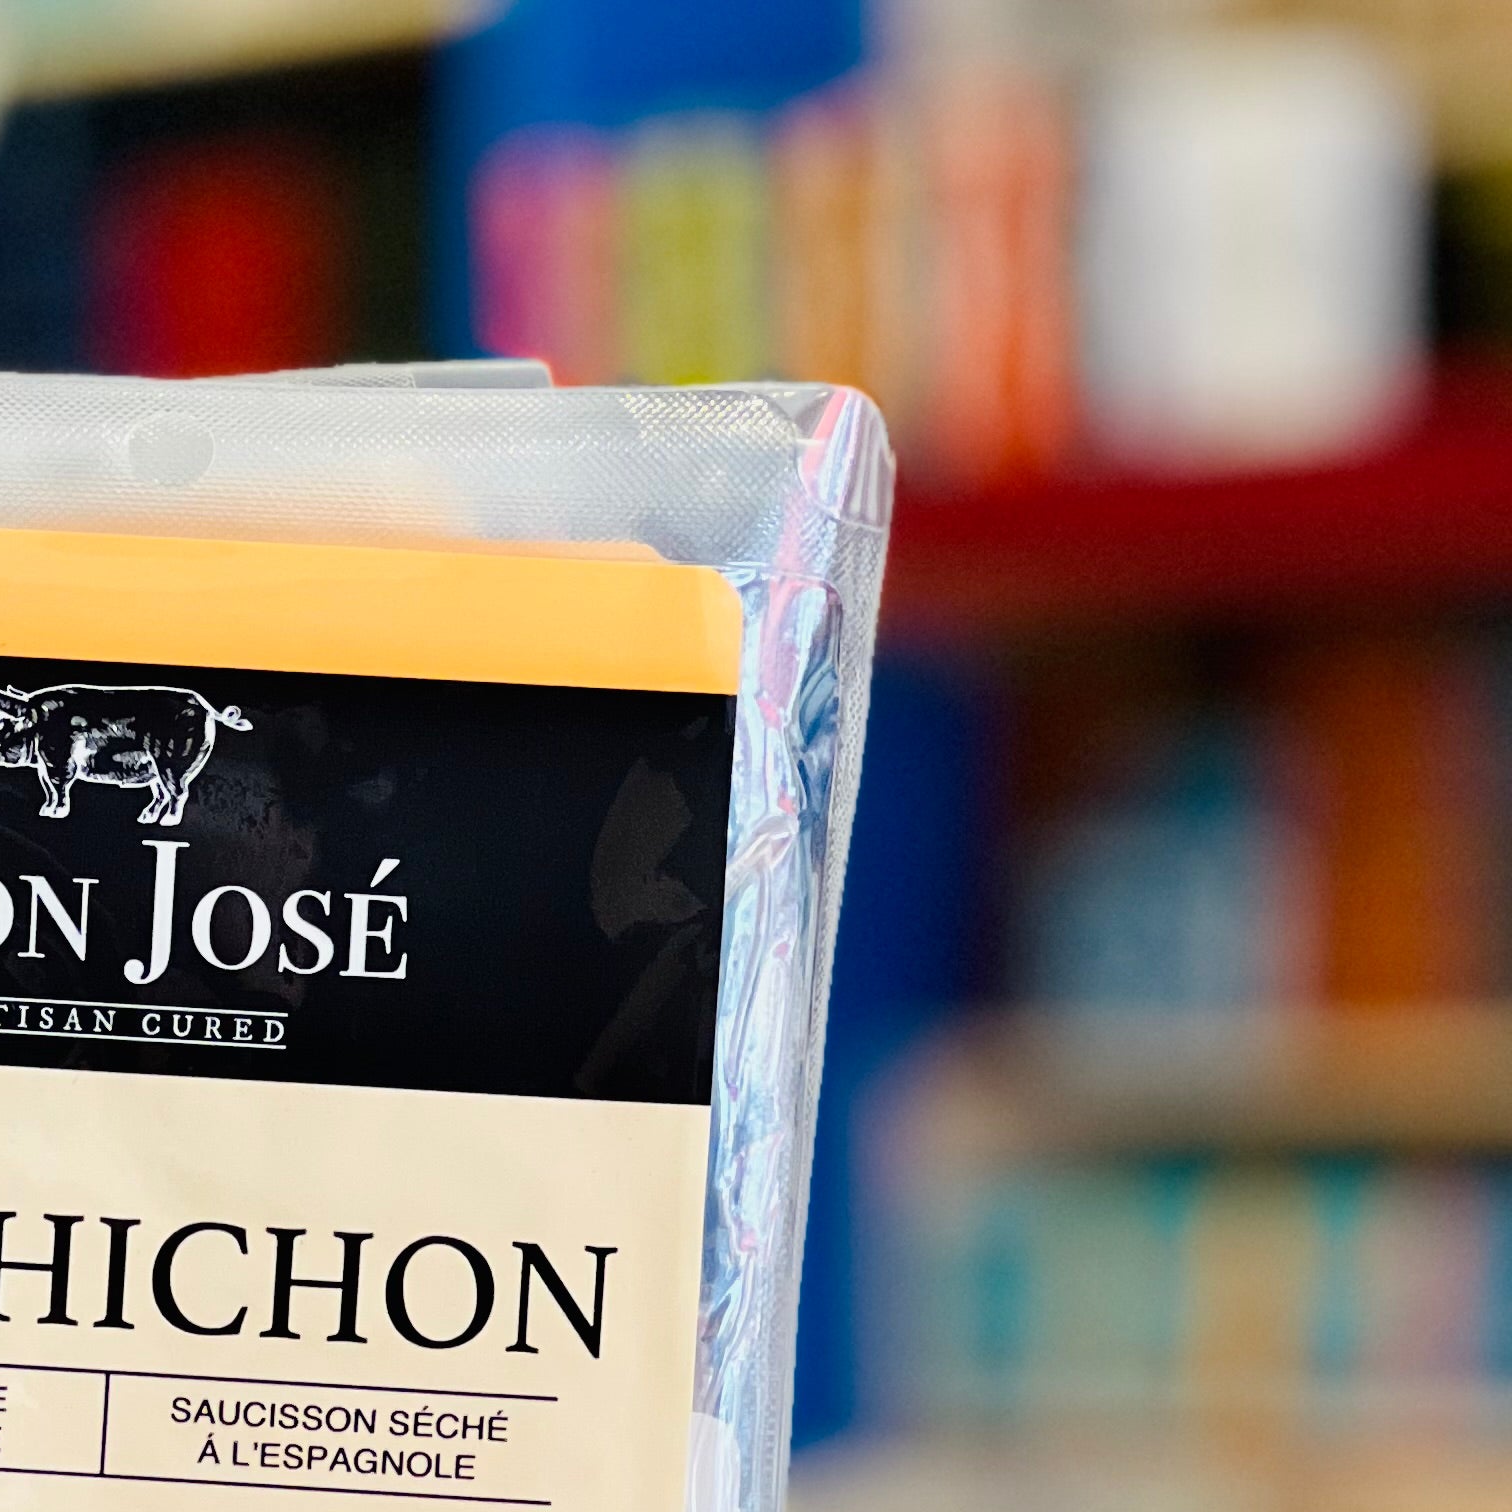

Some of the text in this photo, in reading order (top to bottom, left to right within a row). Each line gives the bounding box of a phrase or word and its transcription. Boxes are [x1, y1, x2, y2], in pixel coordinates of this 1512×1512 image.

[123, 839, 408, 985] JOSÉ
[141, 1013, 286, 1043] CURED
[170, 1396, 509, 1443] SAUCISSON SÉCHÉ
[197, 1432, 477, 1480] Á L'ESPAGNOLE
